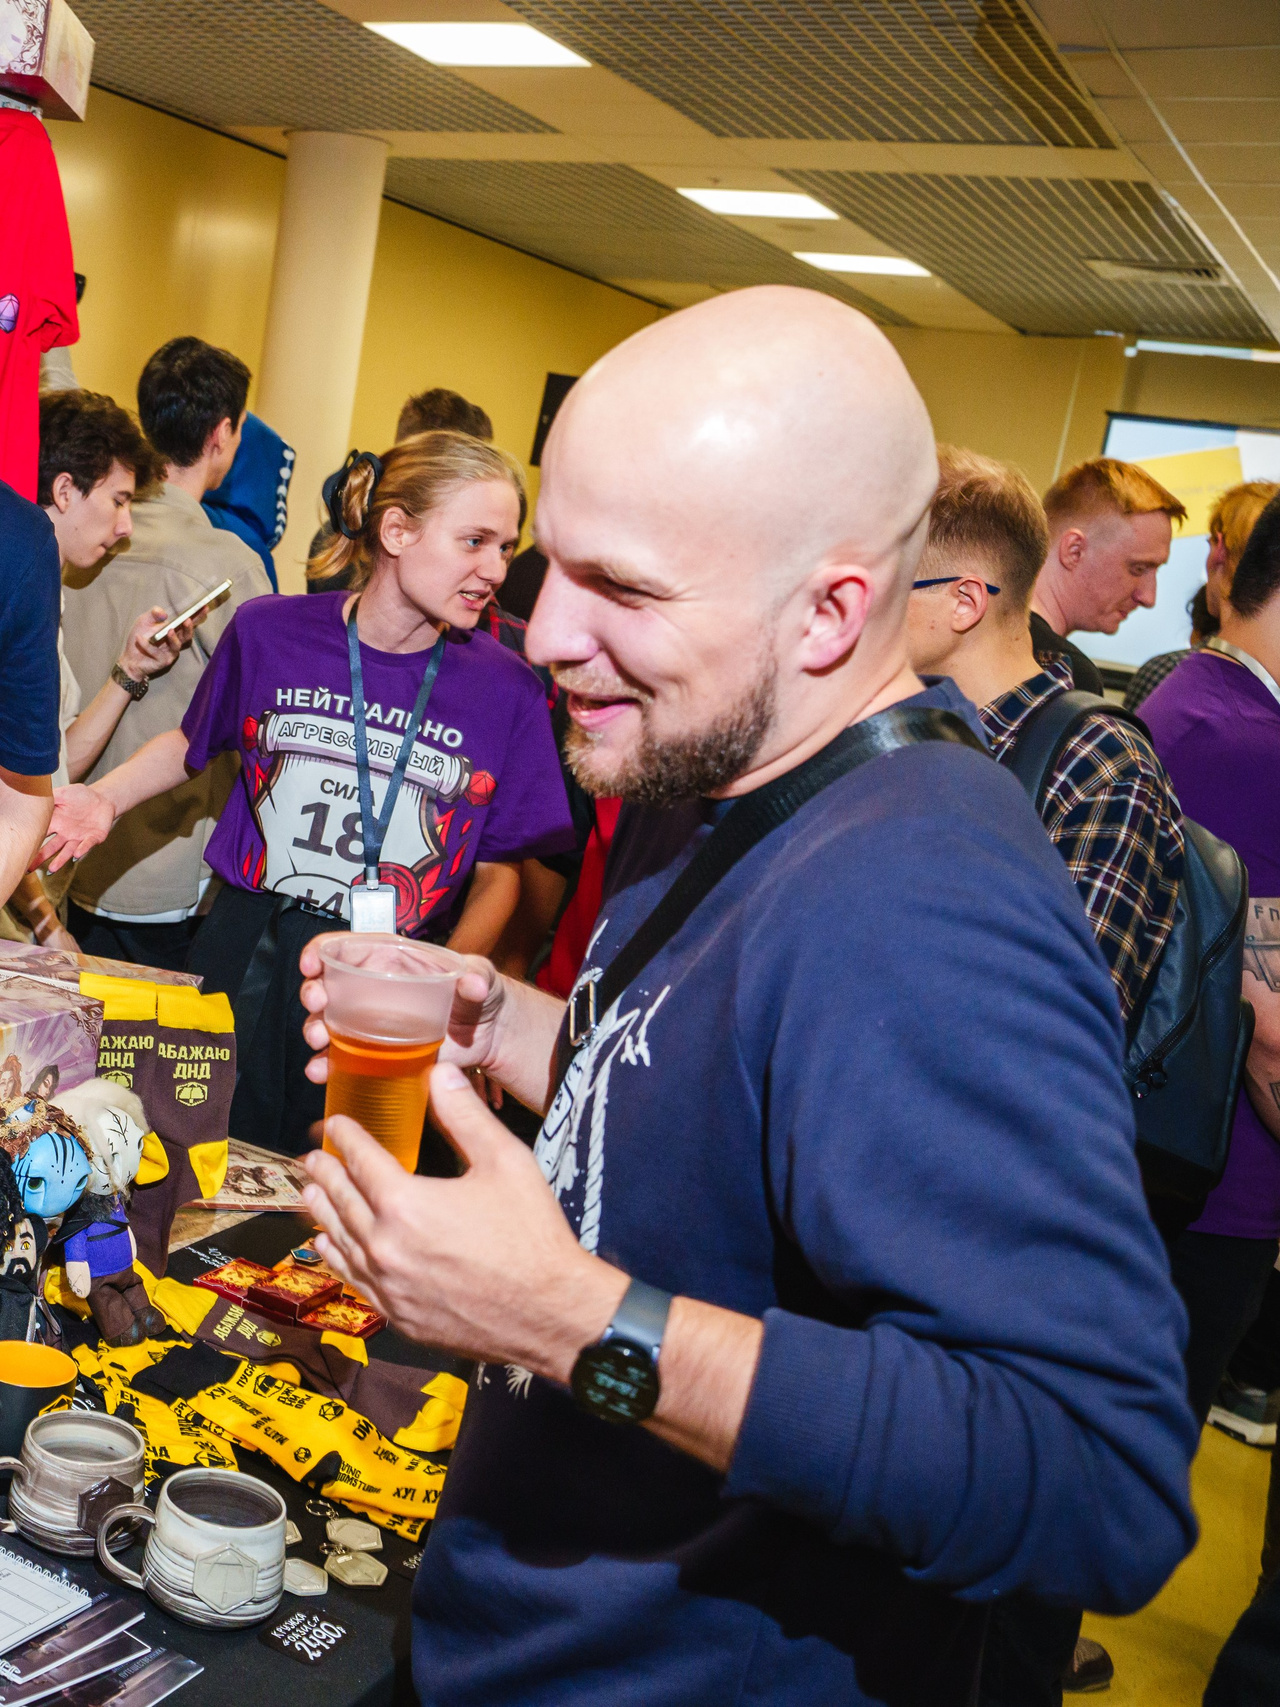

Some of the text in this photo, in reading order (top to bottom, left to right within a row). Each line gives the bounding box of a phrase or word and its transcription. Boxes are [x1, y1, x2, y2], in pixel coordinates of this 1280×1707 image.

[291, 801, 386, 864] 18
[97, 1051, 136, 1069] ДНД
[157, 1042, 231, 1062] АБАЖАЮ
[172, 1062, 212, 1080] ДНД
[270, 1611, 307, 1639] КРУЖКА
